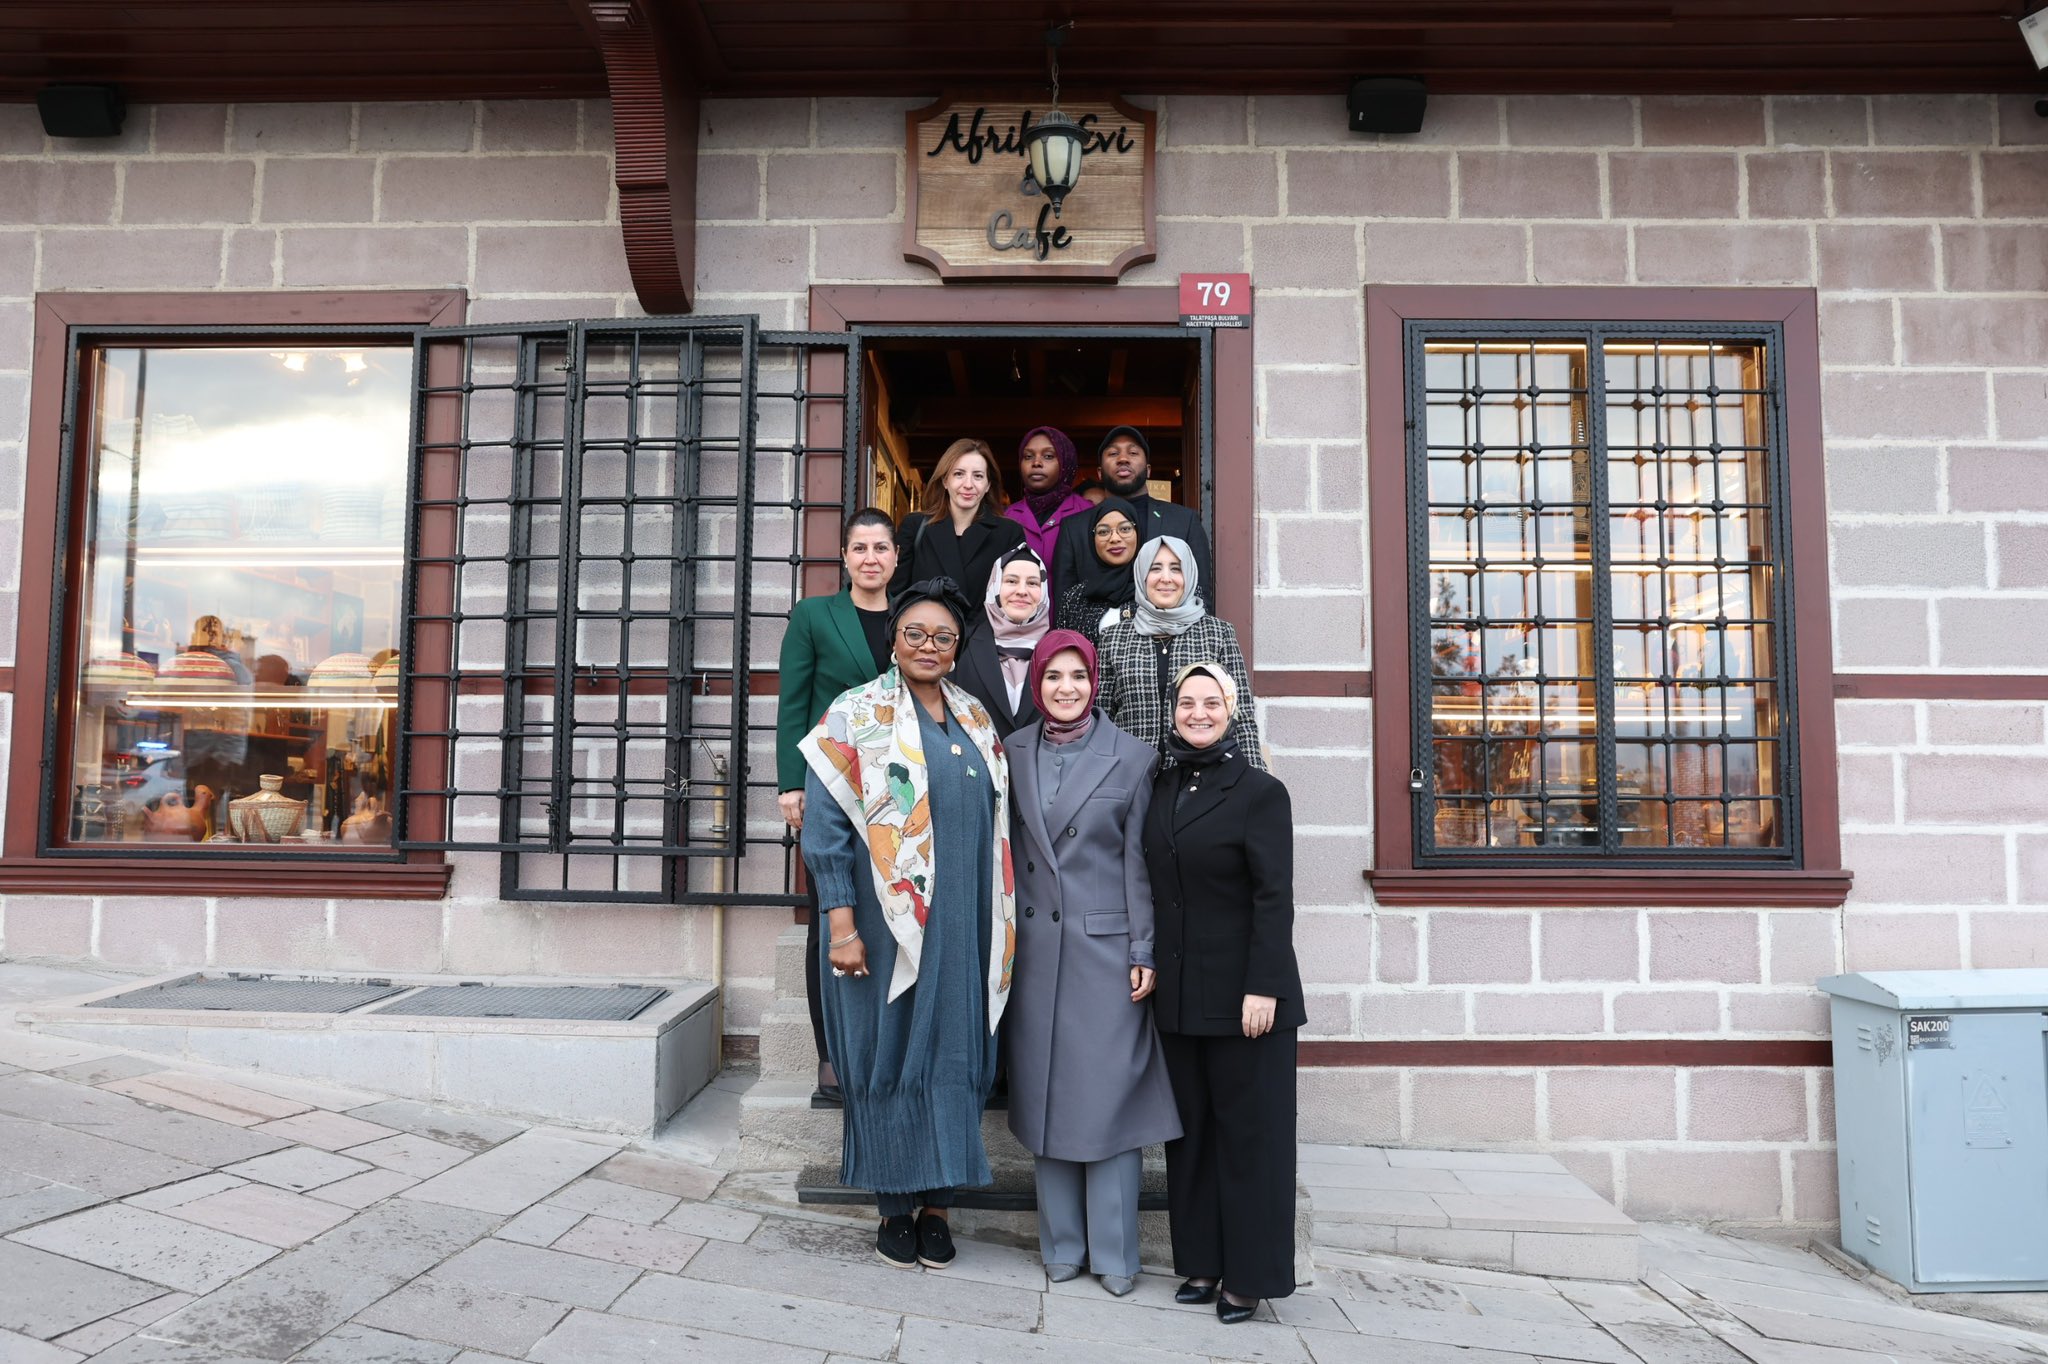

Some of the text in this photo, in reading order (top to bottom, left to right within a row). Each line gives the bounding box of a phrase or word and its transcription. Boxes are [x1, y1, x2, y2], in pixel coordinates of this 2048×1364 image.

[986, 203, 1073, 261] Cafe
[1197, 281, 1231, 307] 79
[1910, 1020, 1950, 1033] SAK200
